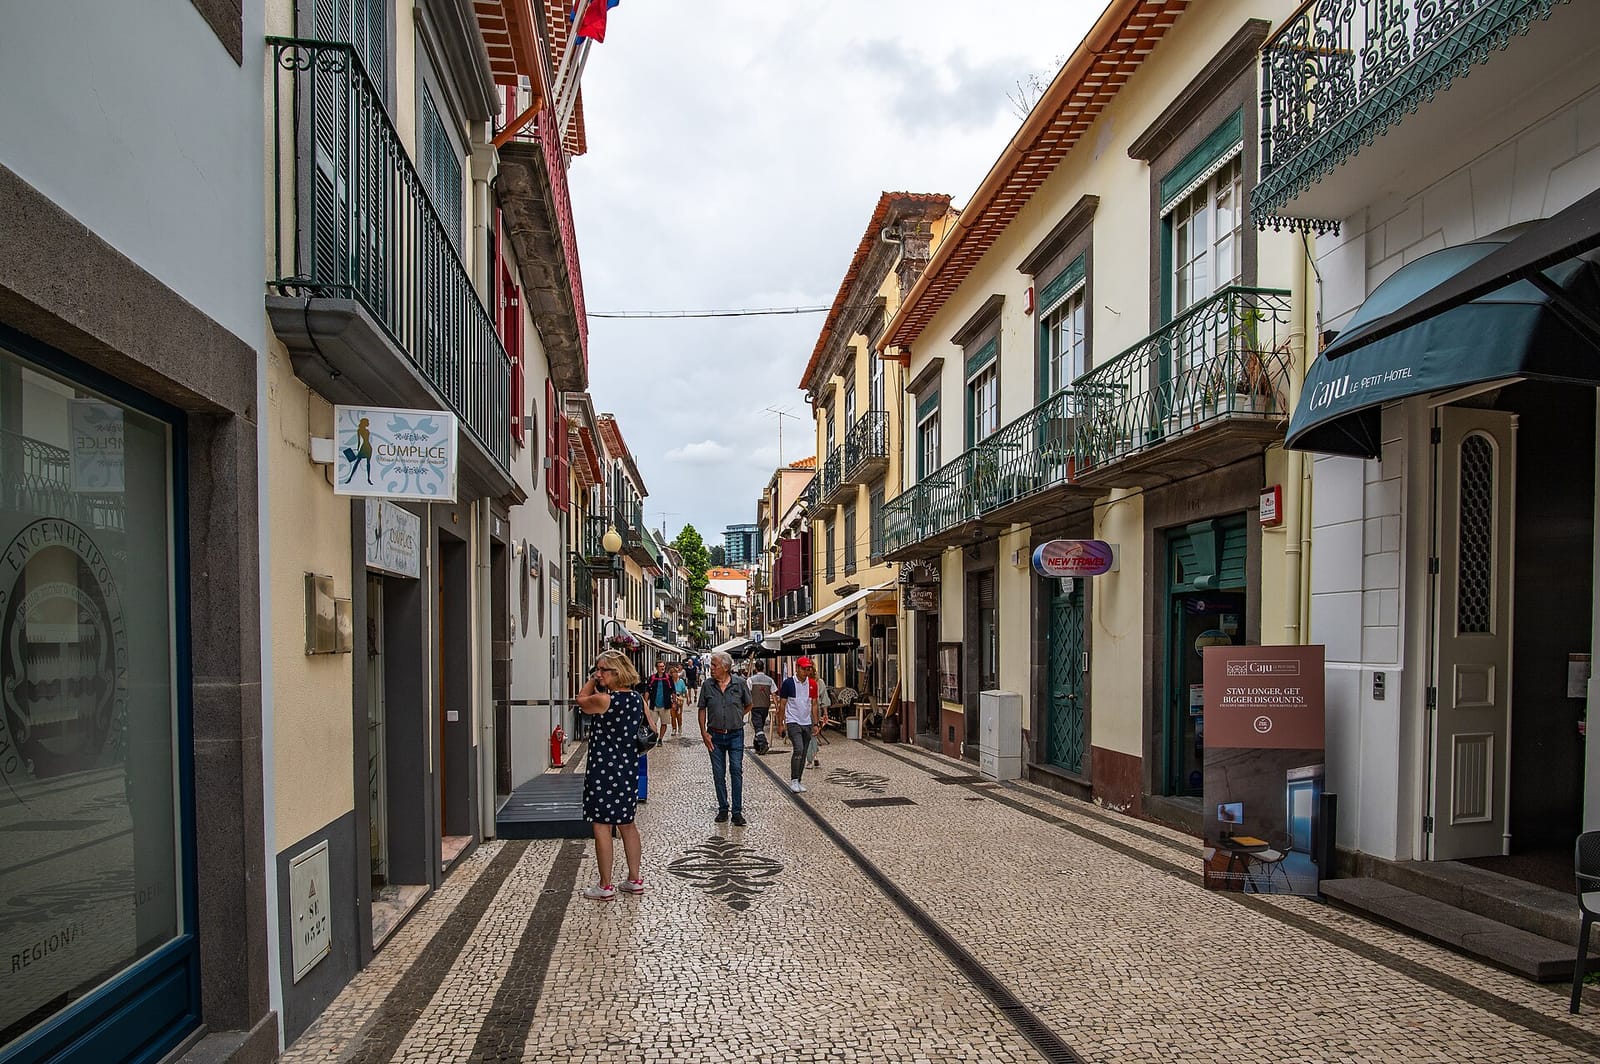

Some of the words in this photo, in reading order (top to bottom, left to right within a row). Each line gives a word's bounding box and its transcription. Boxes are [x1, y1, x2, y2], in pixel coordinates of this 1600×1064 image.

[1309, 374, 1350, 411] Caju
[1349, 382, 1359, 393] LE
[1361, 375, 1382, 389] PETIT
[1384, 367, 1412, 383] HOTEL
[377, 443, 445, 459] CÚMPLICE
[1047, 557, 1071, 566] NEW
[1072, 557, 1105, 566] TRAVEL
[900, 559, 940, 583] RESTAURANTE
[1249, 662, 1272, 674] Caju
[1226, 687, 1246, 695] STAY
[1247, 687, 1282, 696] LONGER,
[1284, 687, 1300, 695] GET
[11, 920, 88, 974] REGIONAL
